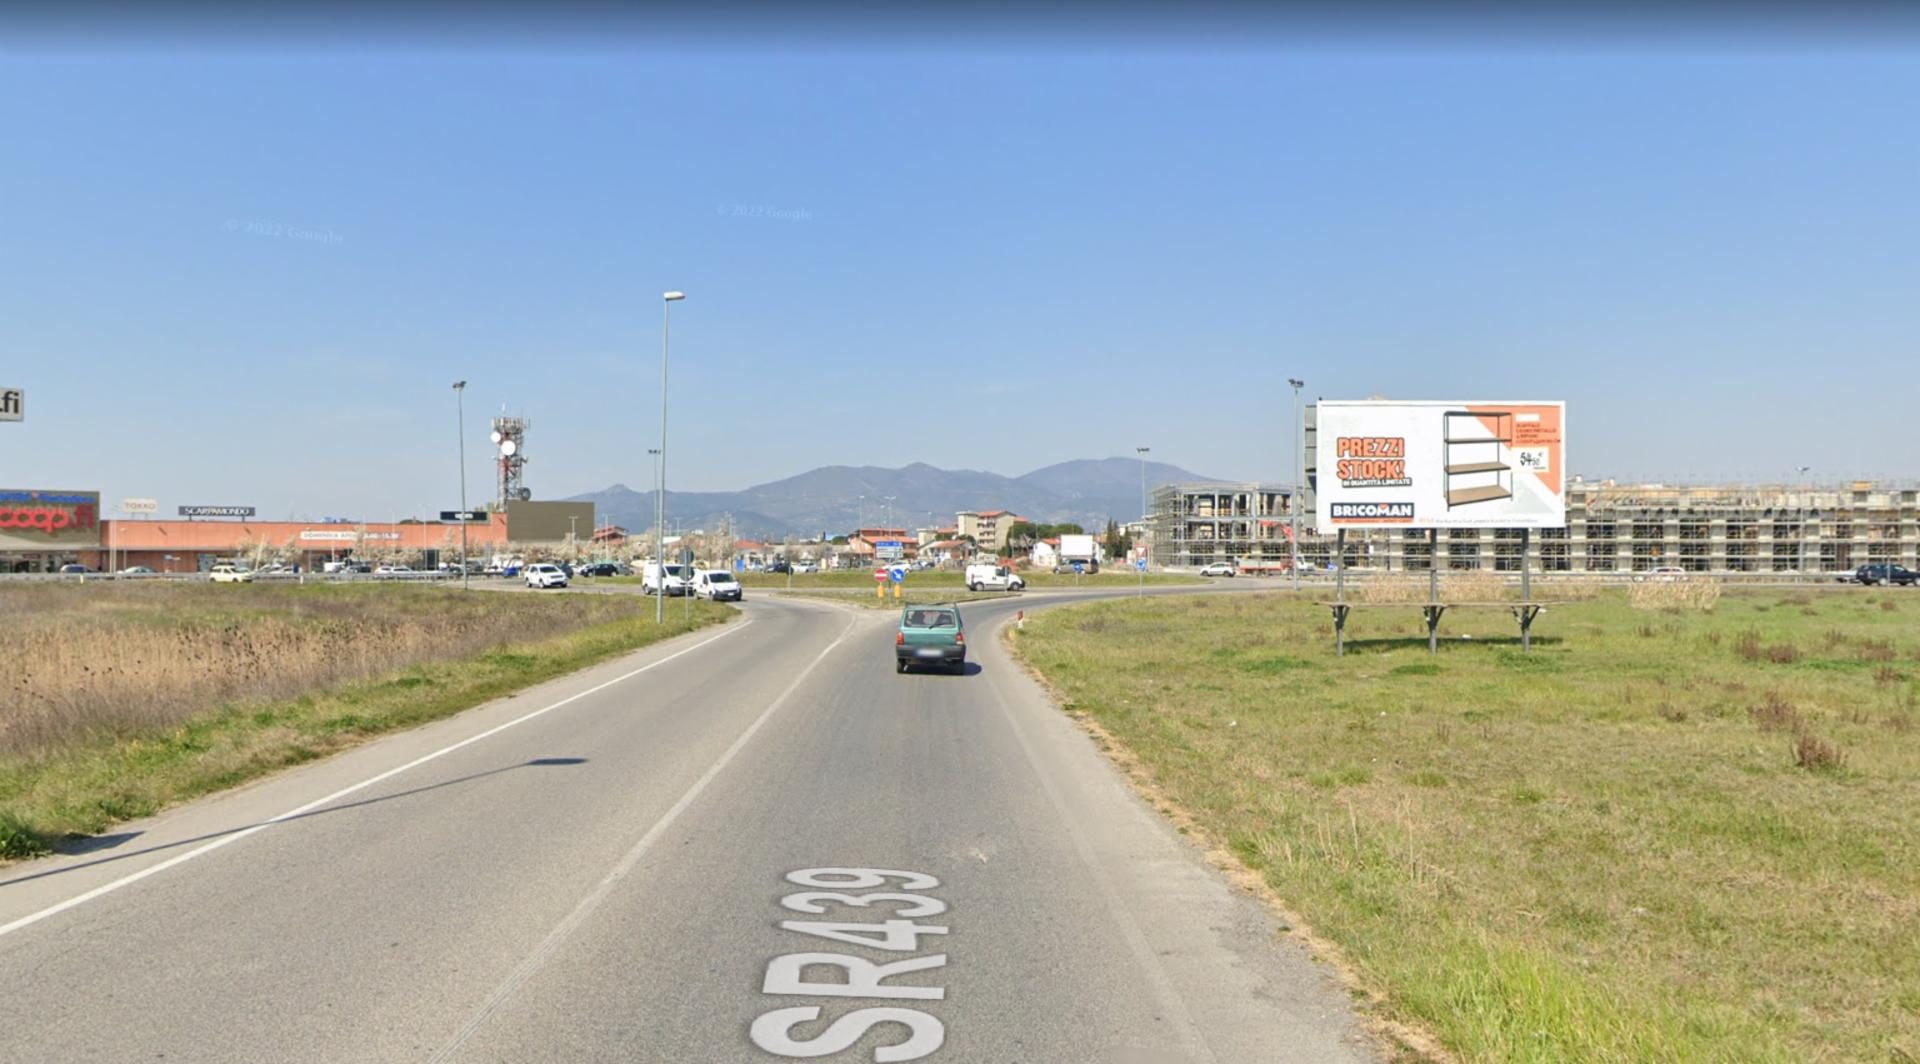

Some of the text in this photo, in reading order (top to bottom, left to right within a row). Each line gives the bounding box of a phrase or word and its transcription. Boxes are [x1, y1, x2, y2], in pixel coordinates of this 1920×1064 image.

[1337, 437, 1404, 457] PREZZI
[1336, 459, 1405, 480] STOCK!
[1333, 504, 1412, 517] BRICOMAN
